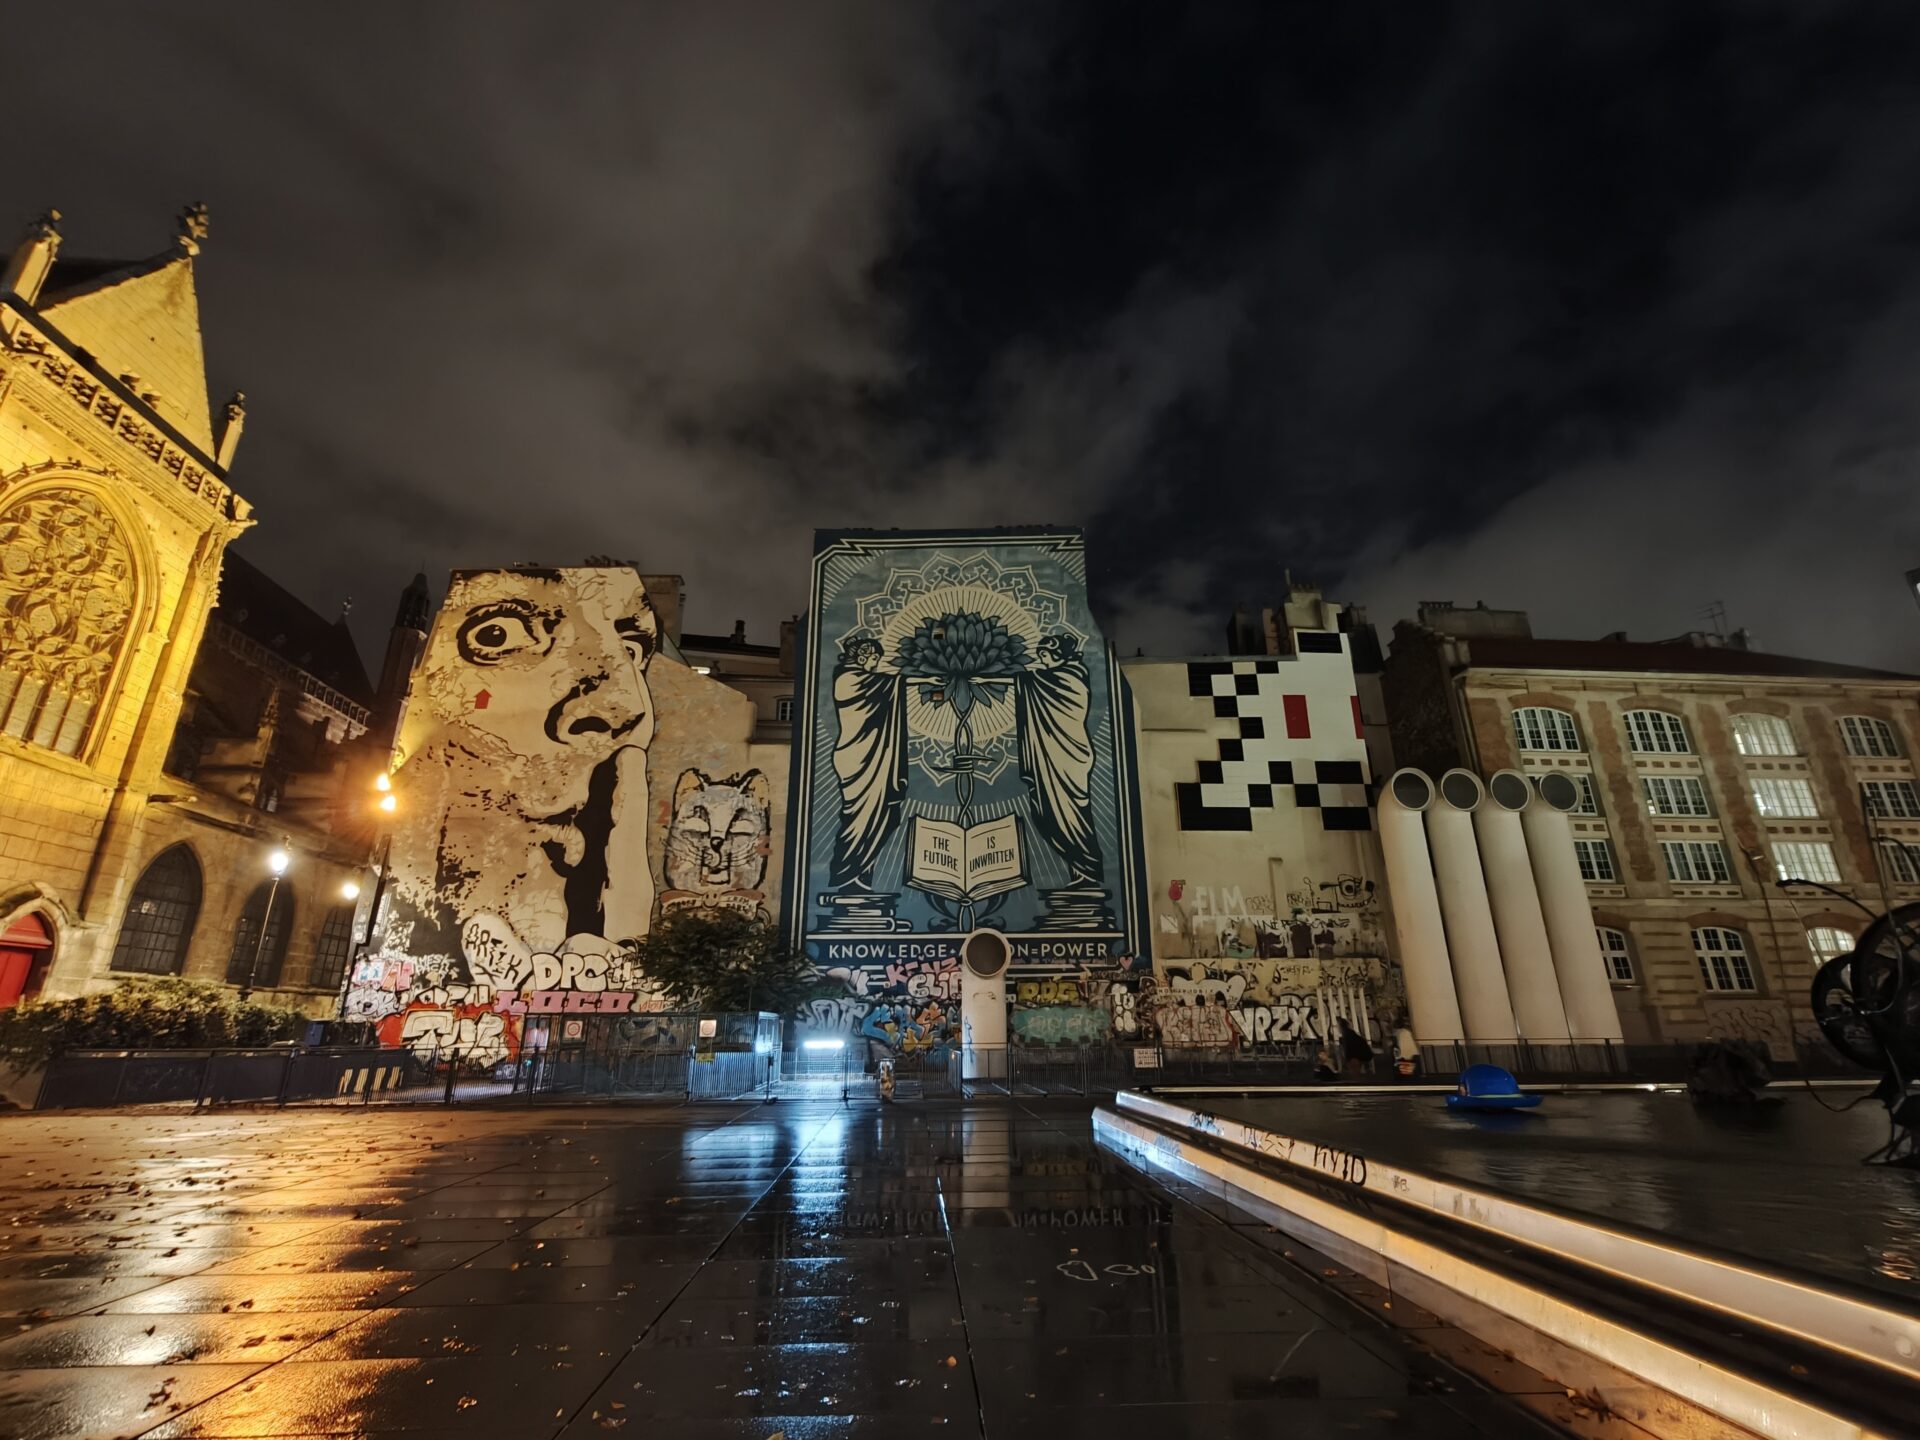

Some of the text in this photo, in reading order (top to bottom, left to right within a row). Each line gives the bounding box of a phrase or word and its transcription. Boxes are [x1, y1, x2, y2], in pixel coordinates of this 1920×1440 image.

[932, 836, 950, 852] THE
[987, 836, 996, 849] IS
[923, 850, 959, 872] FUTURE
[969, 848, 1015, 872] UNWRITTEN
[828, 944, 947, 959] KNOWLEDGE
[530, 952, 611, 992] DPC
[494, 990, 635, 1013] LOCO
